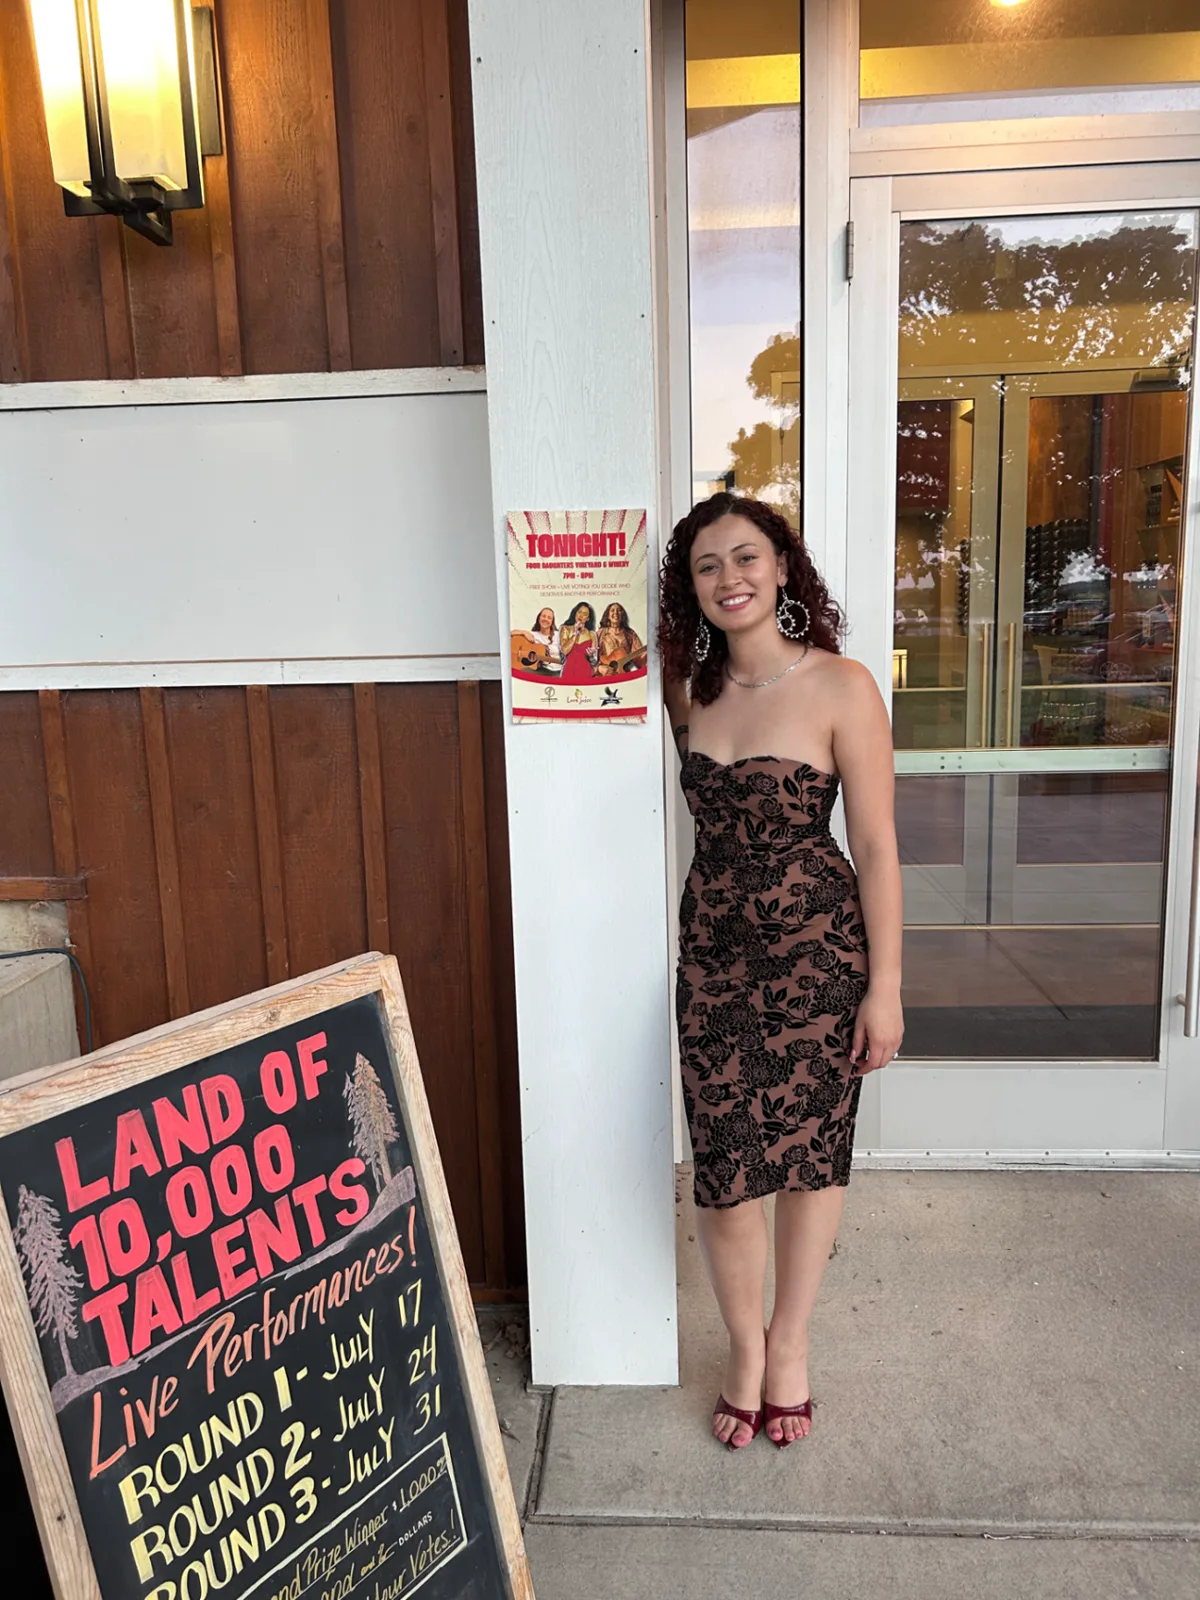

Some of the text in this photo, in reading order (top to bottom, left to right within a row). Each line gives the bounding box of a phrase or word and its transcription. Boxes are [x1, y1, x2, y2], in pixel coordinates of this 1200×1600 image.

[526, 532, 626, 558] TONIGHT!
[55, 1031, 328, 1213] LAND OF
[69, 1124, 296, 1291] 10,000
[82, 1158, 370, 1367] TALENTS
[90, 1205, 417, 1481] Live Performances!
[118, 1392, 264, 1525] ROUND
[399, 1279, 422, 1327] 17
[414, 1384, 440, 1435] 31
[130, 1448, 275, 1584] ROUND
[408, 1325, 436, 1386] 24
[398, 1511, 433, 1546] DOLLARS
[302, 1546, 342, 1582] Prize
[410, 1508, 456, 1579] Votes!
